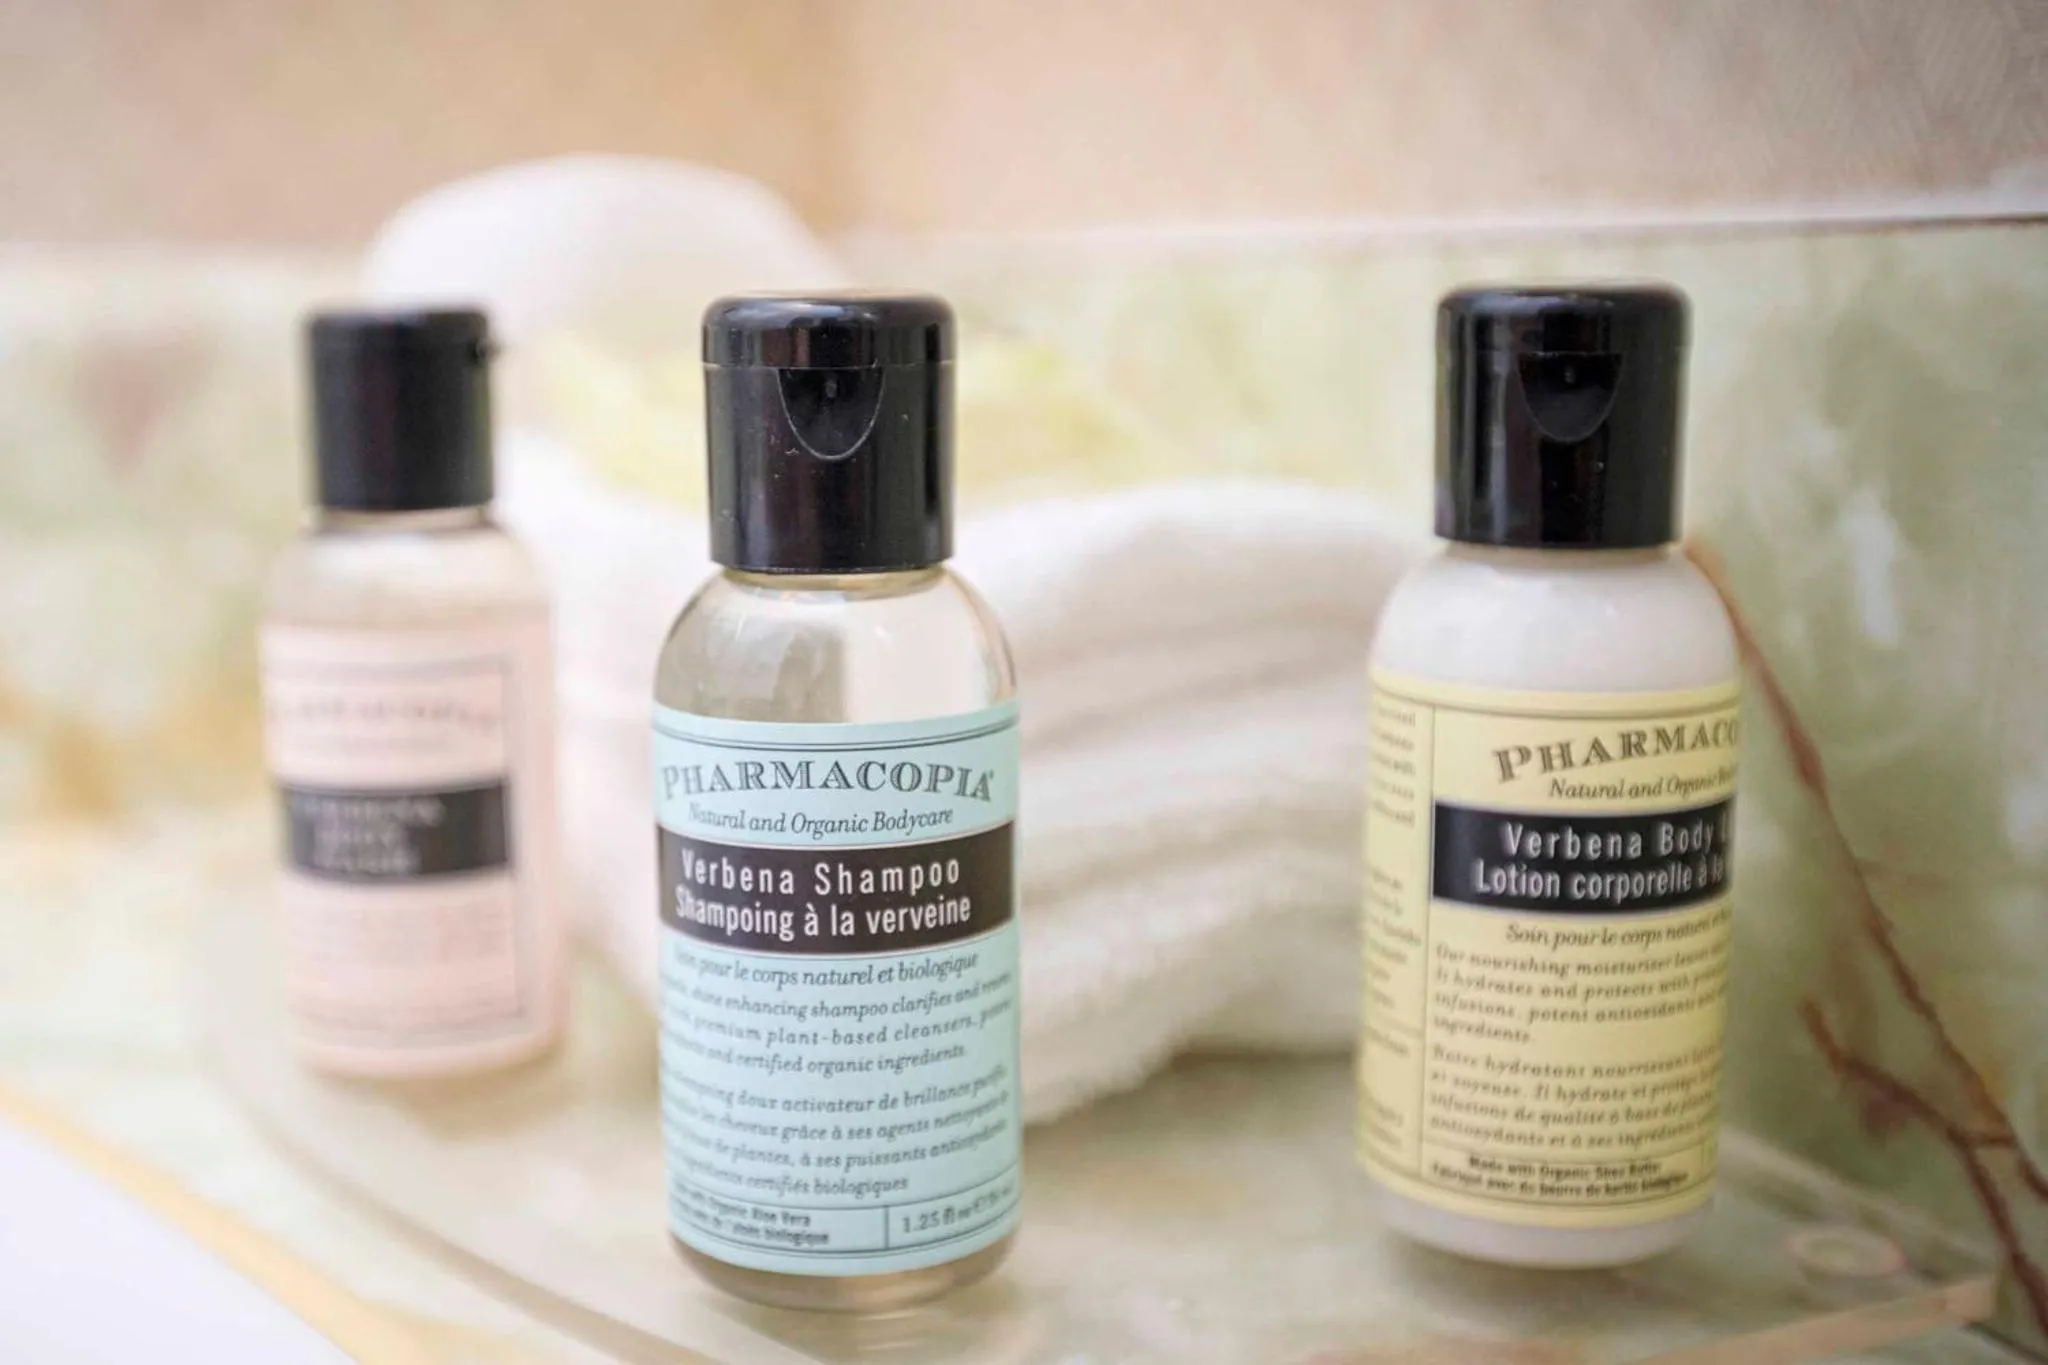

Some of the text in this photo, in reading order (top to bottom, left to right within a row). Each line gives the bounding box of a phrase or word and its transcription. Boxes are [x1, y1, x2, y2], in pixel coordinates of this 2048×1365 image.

[1548, 776, 1625, 800] Natural
[1627, 774, 1664, 798] and
[688, 801, 954, 841] Natural and Organic Bodycare
[1497, 820, 1642, 861] Verbena
[1647, 815, 1714, 855] Body
[681, 847, 961, 897] Verbena Shampoo
[1471, 856, 1562, 898] Lotion
[1560, 861, 1692, 908] corporelle
[675, 883, 973, 944] Shampoing à la verveine
[1505, 922, 1549, 944] Soin
[1550, 928, 1600, 952] pour
[1600, 926, 1618, 946] le
[1619, 929, 1665, 952] corps
[734, 959, 751, 981] le
[751, 967, 799, 992] corps
[801, 964, 876, 986] naturel
[877, 966, 897, 984] et
[898, 951, 980, 984] biologique
[1539, 980, 1579, 999] and
[725, 994, 808, 1024] enhancing
[810, 999, 889, 1025] shampoo
[890, 989, 954, 1017] clarifies
[766, 1025, 889, 1049] plant-based
[807, 1055, 876, 1080] organic
[780, 1096, 876, 1114] activateur
[877, 1092, 900, 1112] de
[781, 1124, 829, 1145] grâce
[831, 1124, 843, 1141] à
[846, 1126, 874, 1141] ses
[876, 1118, 930, 1144] agents
[799, 1152, 812, 1169] à
[816, 1154, 842, 1169] ses
[812, 1177, 909, 1201] biologiques
[902, 1209, 941, 1234] 1.25
